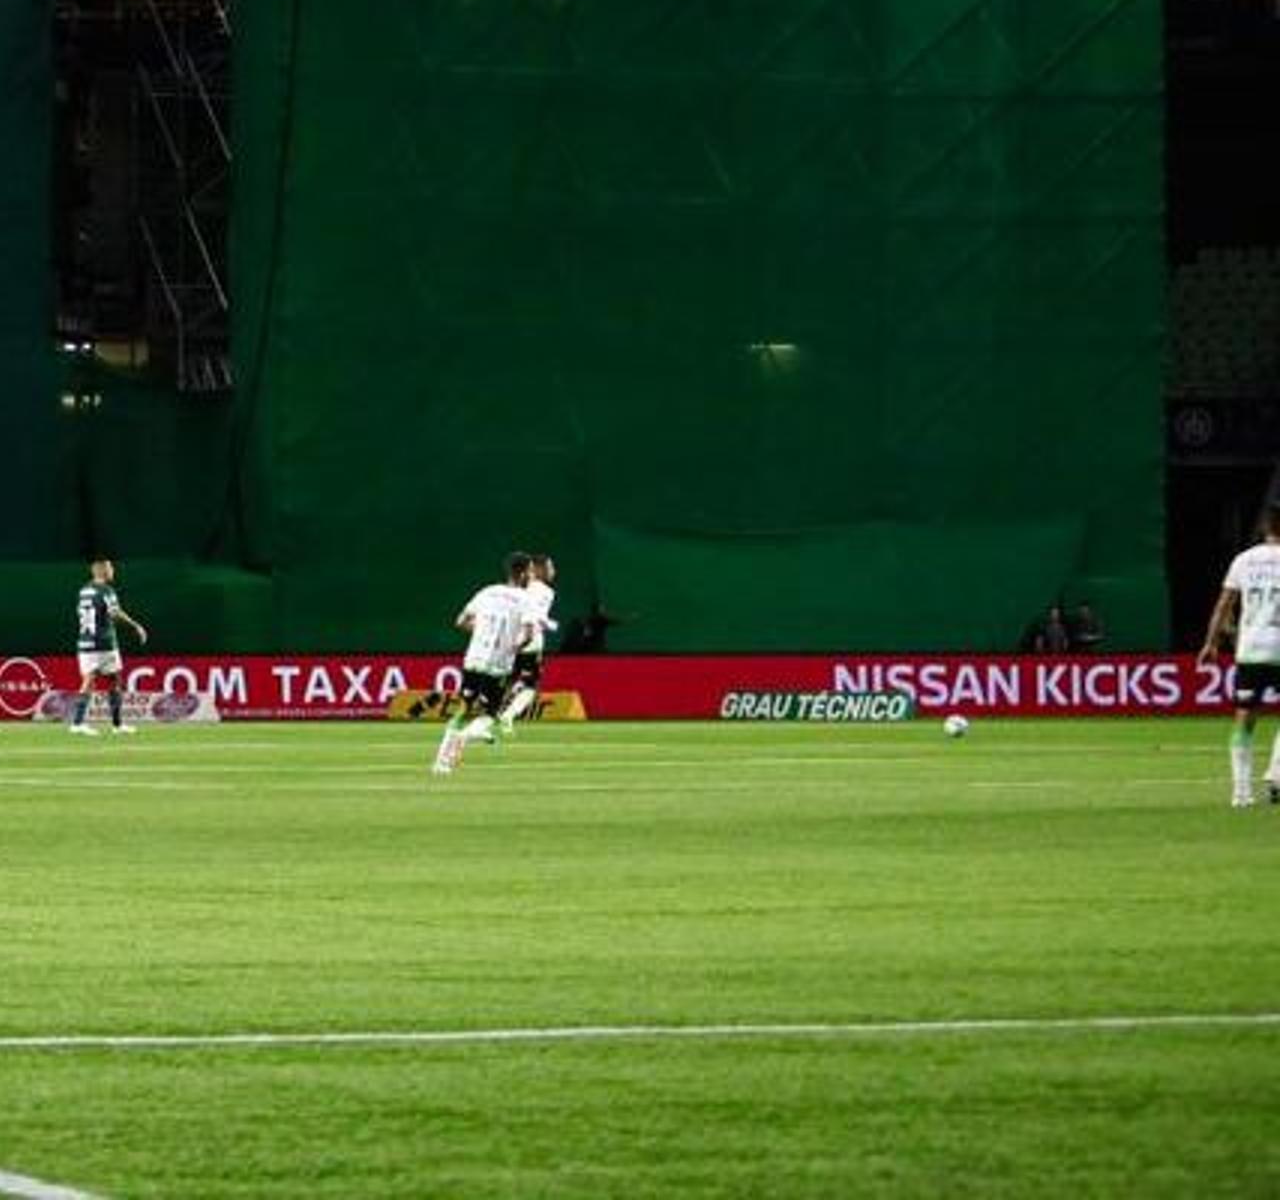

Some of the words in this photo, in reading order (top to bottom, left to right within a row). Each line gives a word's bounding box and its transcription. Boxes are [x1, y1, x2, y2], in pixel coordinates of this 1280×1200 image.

[127, 666, 247, 704] COM
[272, 665, 408, 704] TAXA
[834, 664, 1020, 706] NISSAN
[1037, 663, 1181, 707] KICKS
[721, 693, 791, 719] GRAU
[797, 690, 908, 720] TÉCNICO
